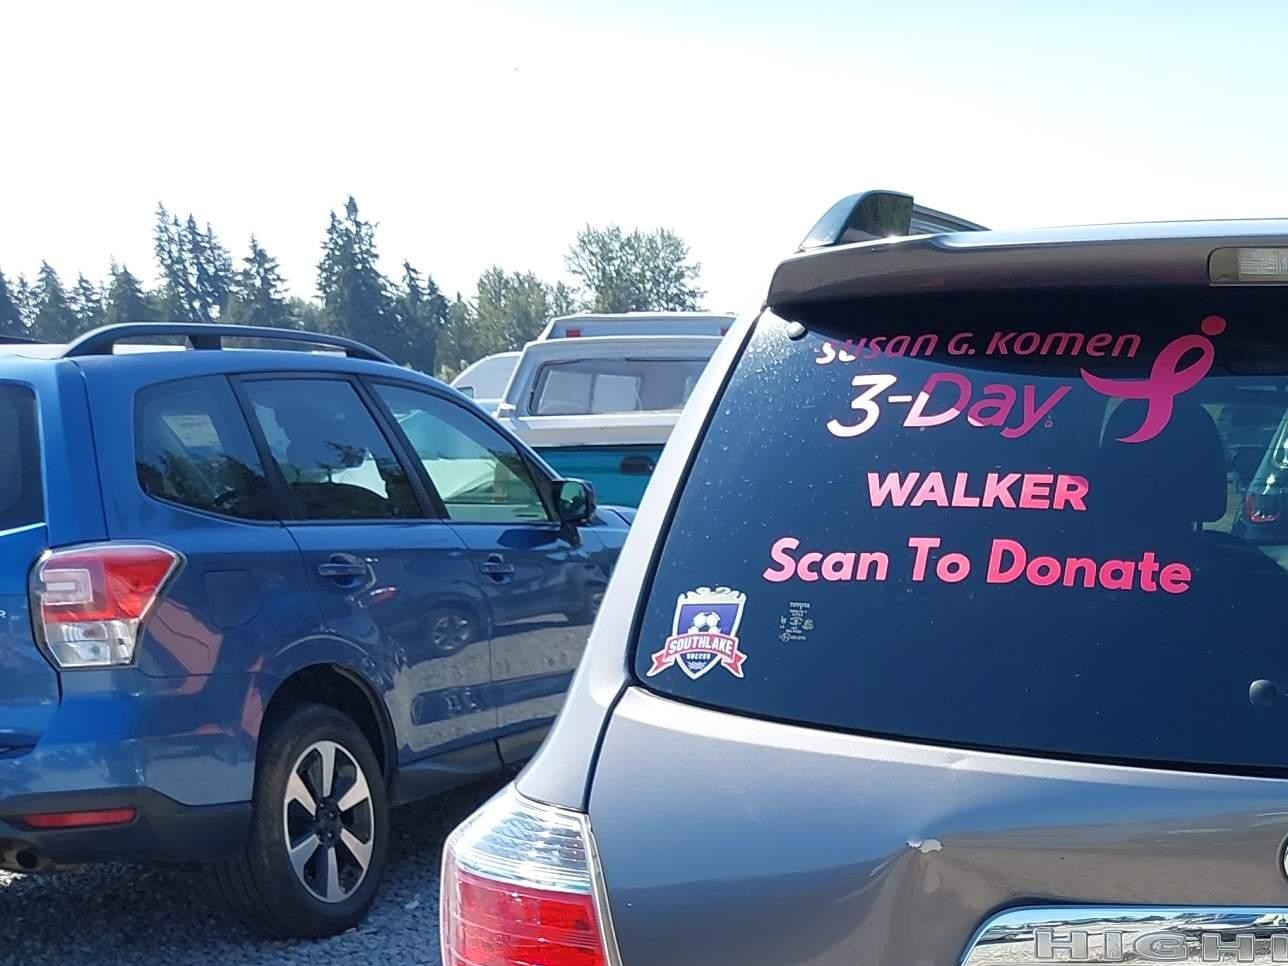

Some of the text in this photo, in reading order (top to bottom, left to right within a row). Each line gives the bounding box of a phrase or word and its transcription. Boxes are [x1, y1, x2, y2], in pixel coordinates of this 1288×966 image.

[867, 471, 1089, 511] WALKER
[762, 537, 1192, 595] Scan To Donate
[667, 635, 734, 655] SOUTHLAKE
